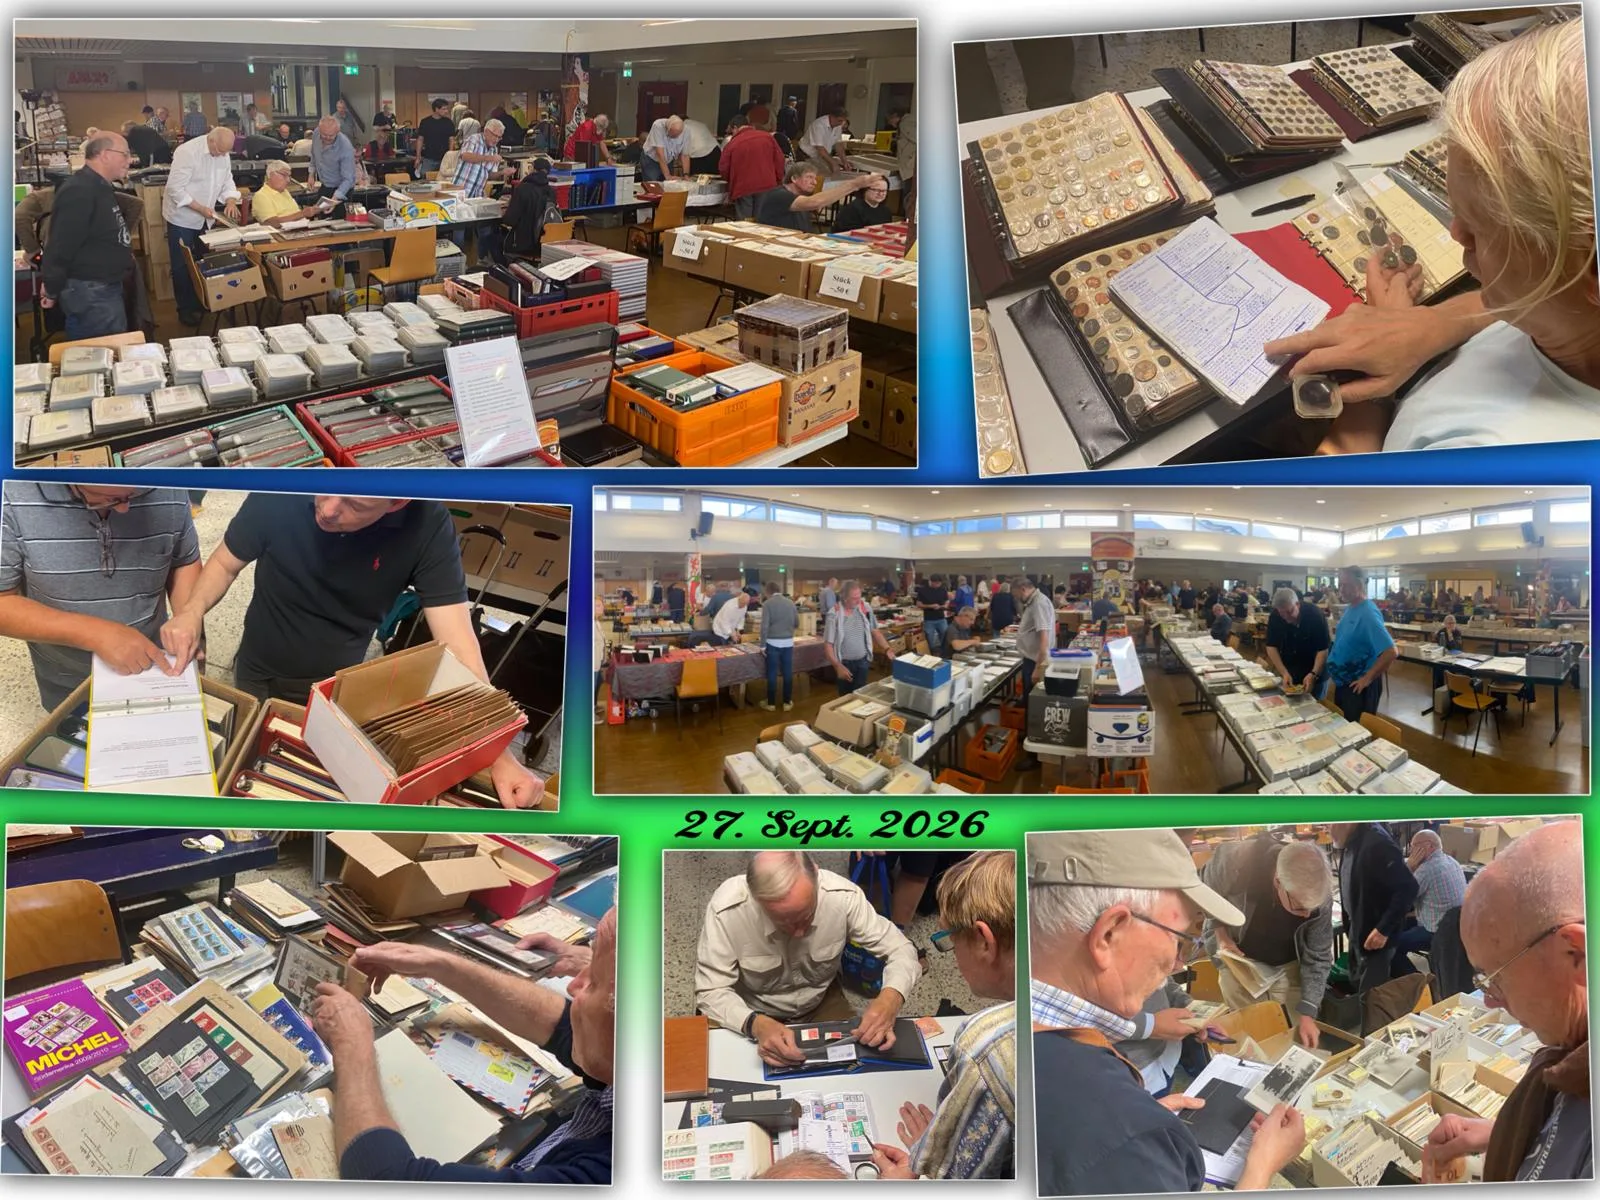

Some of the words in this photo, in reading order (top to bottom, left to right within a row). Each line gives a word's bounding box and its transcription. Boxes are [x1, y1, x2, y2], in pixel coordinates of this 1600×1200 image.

[832, 274, 851, 285] Stück
[1044, 706, 1071, 723] CREW
[25, 1031, 119, 1076] MICHEL
